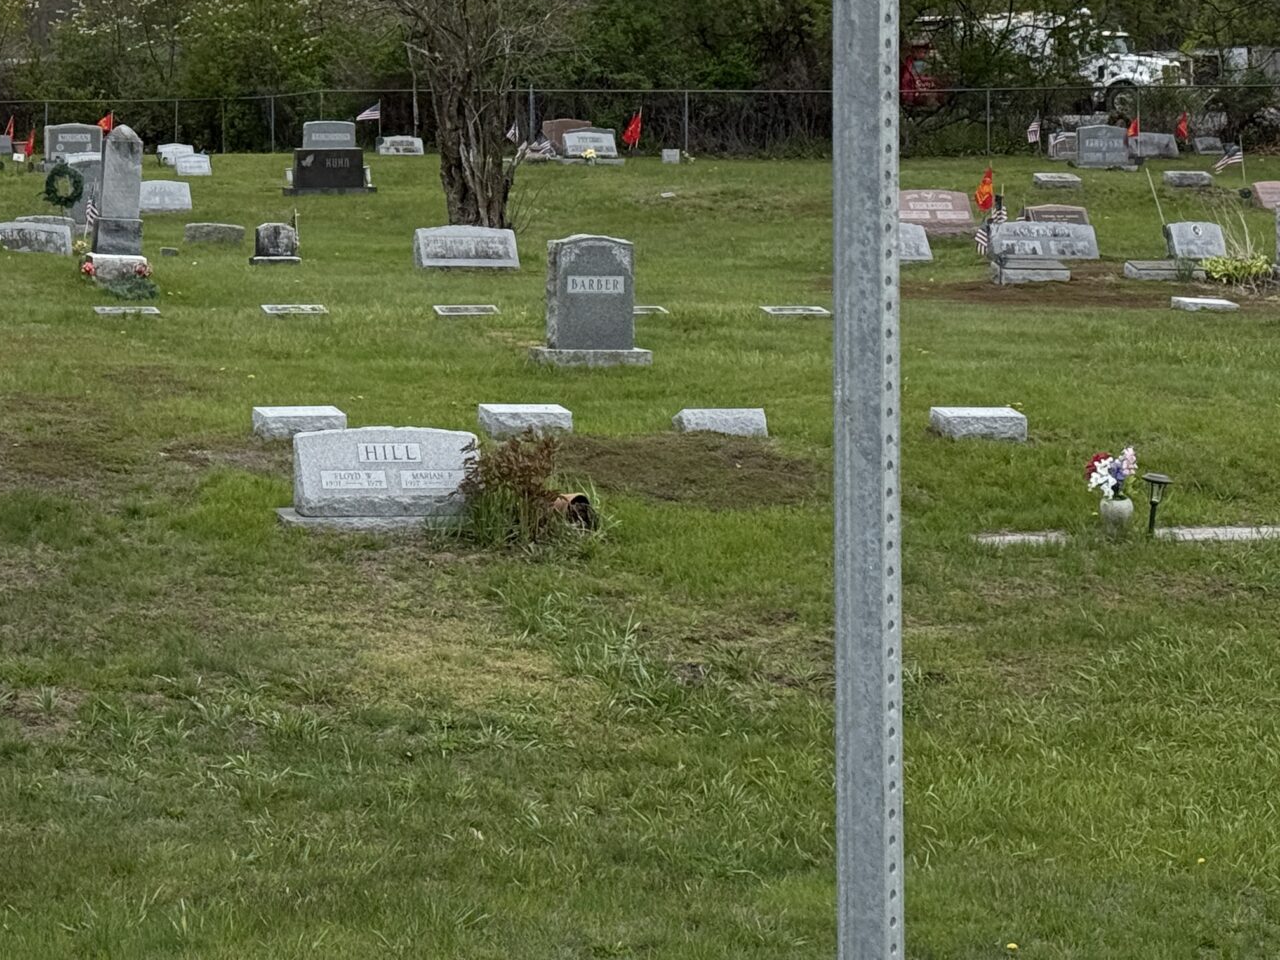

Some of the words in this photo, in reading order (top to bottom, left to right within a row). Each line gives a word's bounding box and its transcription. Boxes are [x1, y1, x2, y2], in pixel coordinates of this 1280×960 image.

[571, 278, 620, 291] BARBER
[364, 445, 417, 461] HILL
[333, 472, 361, 480] FLOYD
[411, 472, 444, 480] MARIAN
